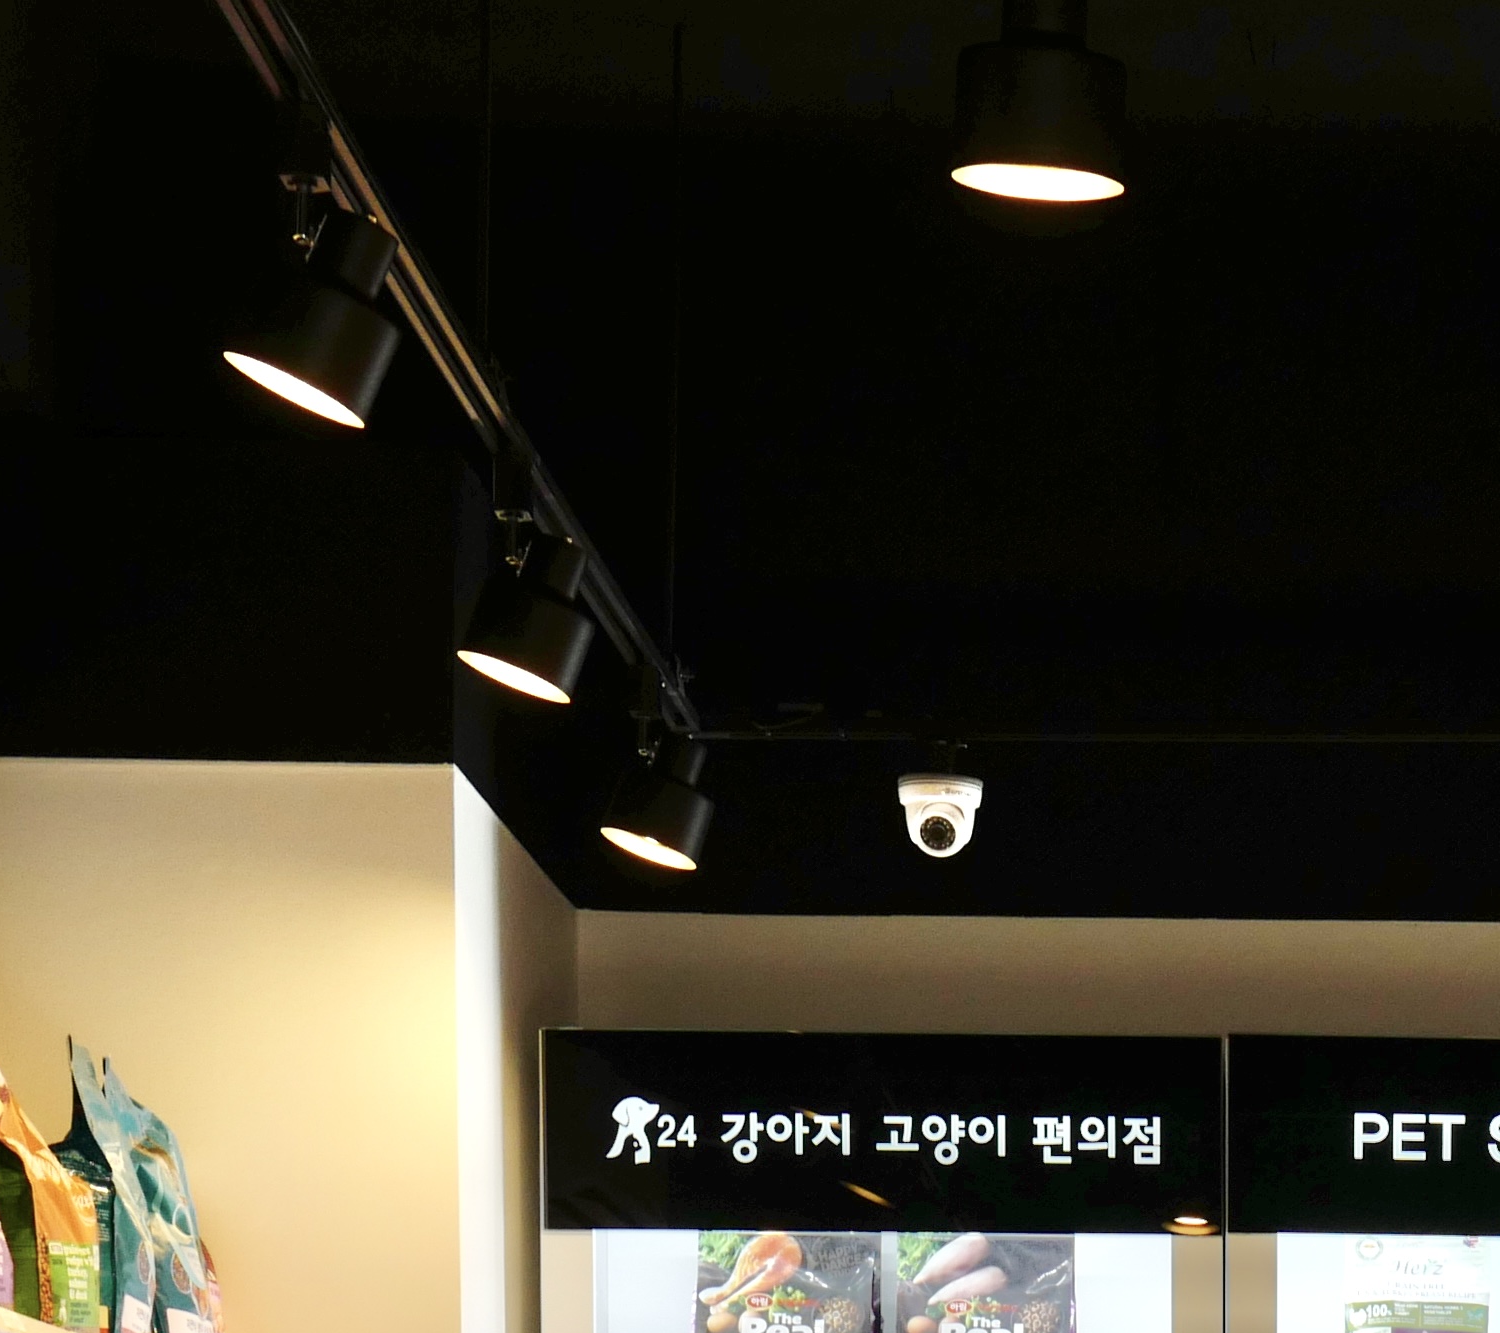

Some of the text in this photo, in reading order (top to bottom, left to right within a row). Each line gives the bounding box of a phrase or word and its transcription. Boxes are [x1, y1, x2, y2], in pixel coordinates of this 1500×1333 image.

[658, 1112, 1162, 1166] 24 강아지 고양이 편의점
[1353, 1113, 1465, 1161] PET
[773, 1312, 802, 1326] The
